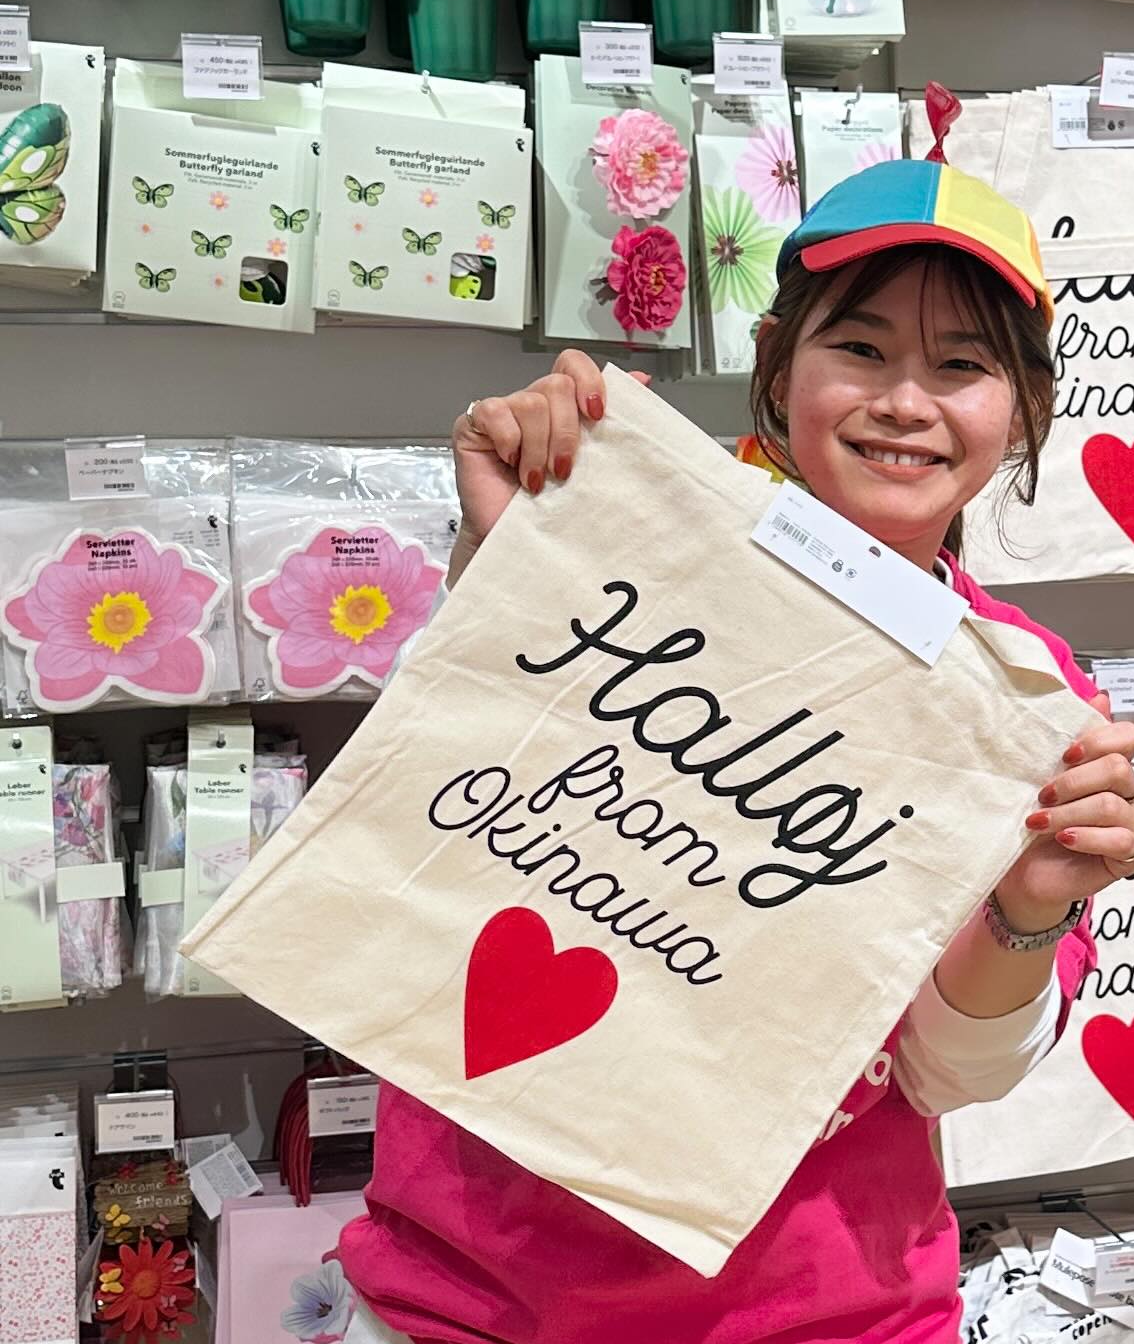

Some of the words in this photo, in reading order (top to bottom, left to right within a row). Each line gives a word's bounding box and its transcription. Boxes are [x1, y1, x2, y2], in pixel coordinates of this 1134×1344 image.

[179, 160, 223, 175] Butterfly
[225, 167, 263, 179] garland
[389, 158, 432, 173] Butterfly
[434, 164, 471, 176] garland
[86, 539, 135, 549] Servietter
[330, 536, 379, 545] Servietter
[91, 549, 132, 559] Napkins
[335, 546, 375, 556] Napkins
[516, 580, 914, 909] Halløj
[527, 744, 726, 887] from
[428, 766, 723, 986] Okinawa
